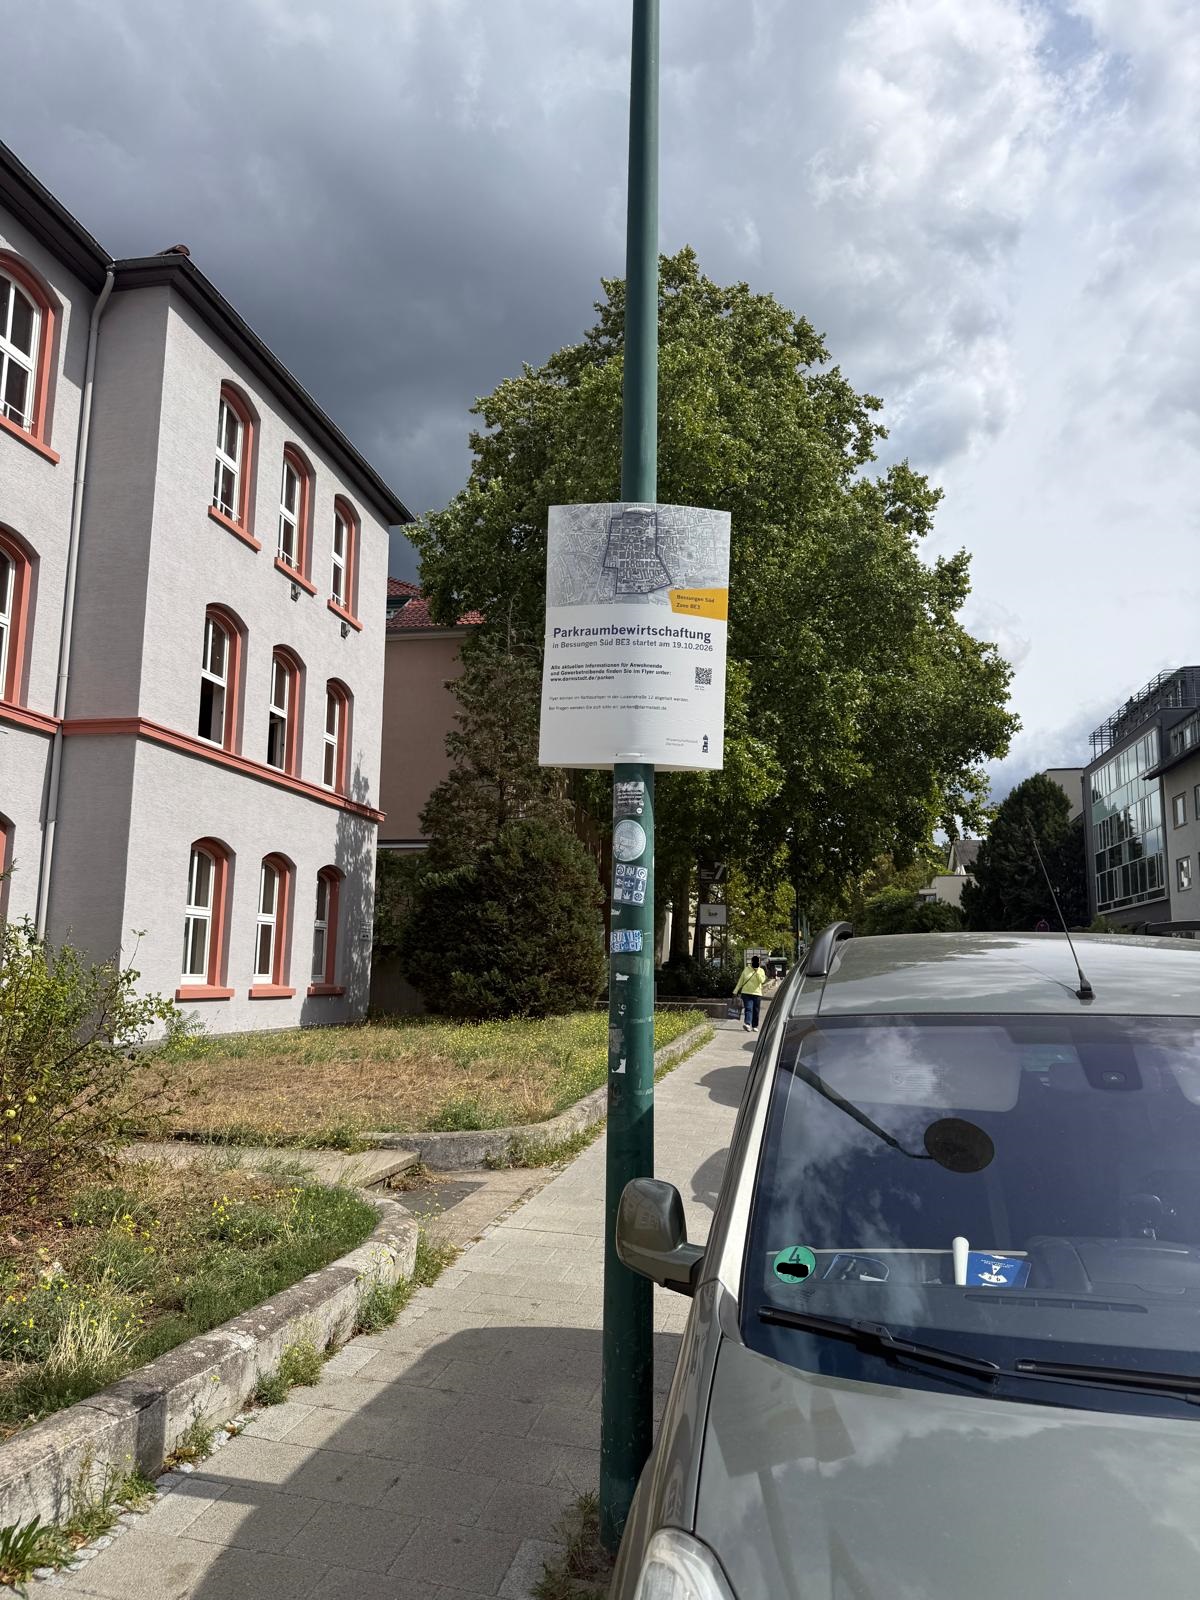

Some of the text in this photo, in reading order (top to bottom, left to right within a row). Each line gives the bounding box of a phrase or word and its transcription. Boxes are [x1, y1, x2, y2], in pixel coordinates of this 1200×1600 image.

[553, 624, 712, 644] Parkraumbewirtschaftung
[560, 641, 598, 649] Bessungen
[599, 638, 614, 647] Süd
[615, 638, 631, 646] BE3
[632, 639, 657, 647] startet
[672, 641, 713, 652] 19.10.2026
[788, 1247, 801, 1264] 4
